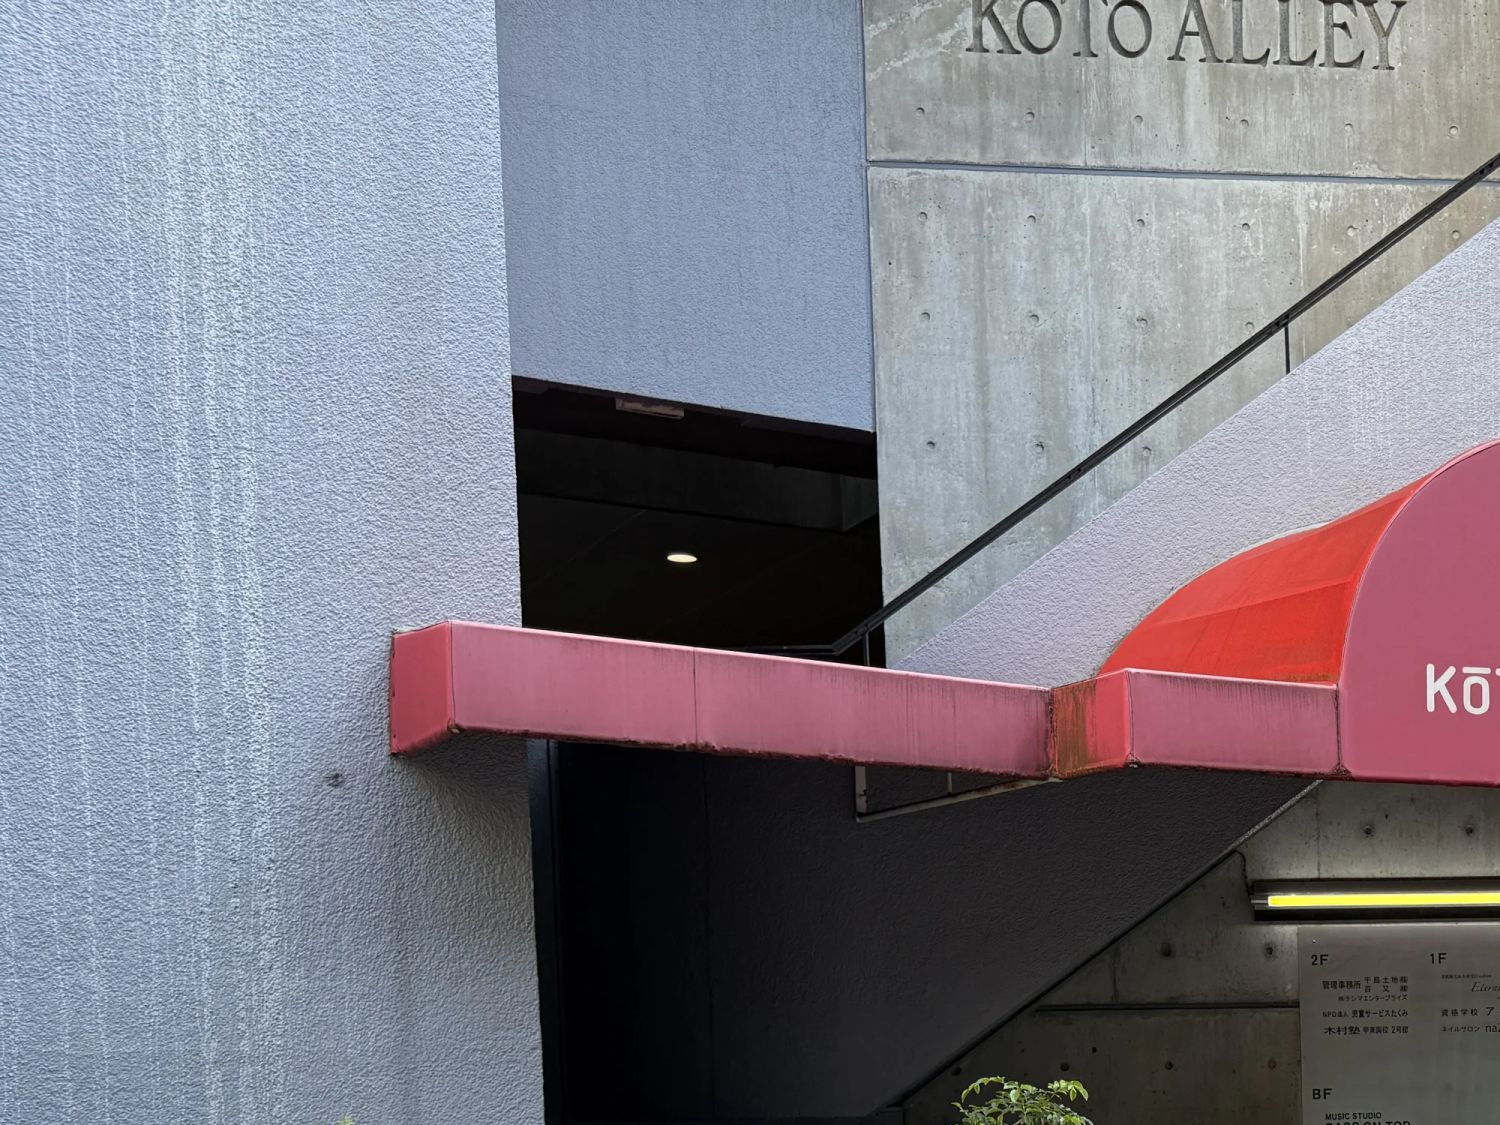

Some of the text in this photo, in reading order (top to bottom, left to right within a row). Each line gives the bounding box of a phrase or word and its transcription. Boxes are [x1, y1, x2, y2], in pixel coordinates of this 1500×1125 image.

[1167, 0, 1405, 71] ALLEY
[1311, 953, 1329, 966] 2F
[1430, 952, 1447, 964] 1F
[1312, 1088, 1332, 1100] BF
[1352, 1112, 1382, 1120] STUDIO
